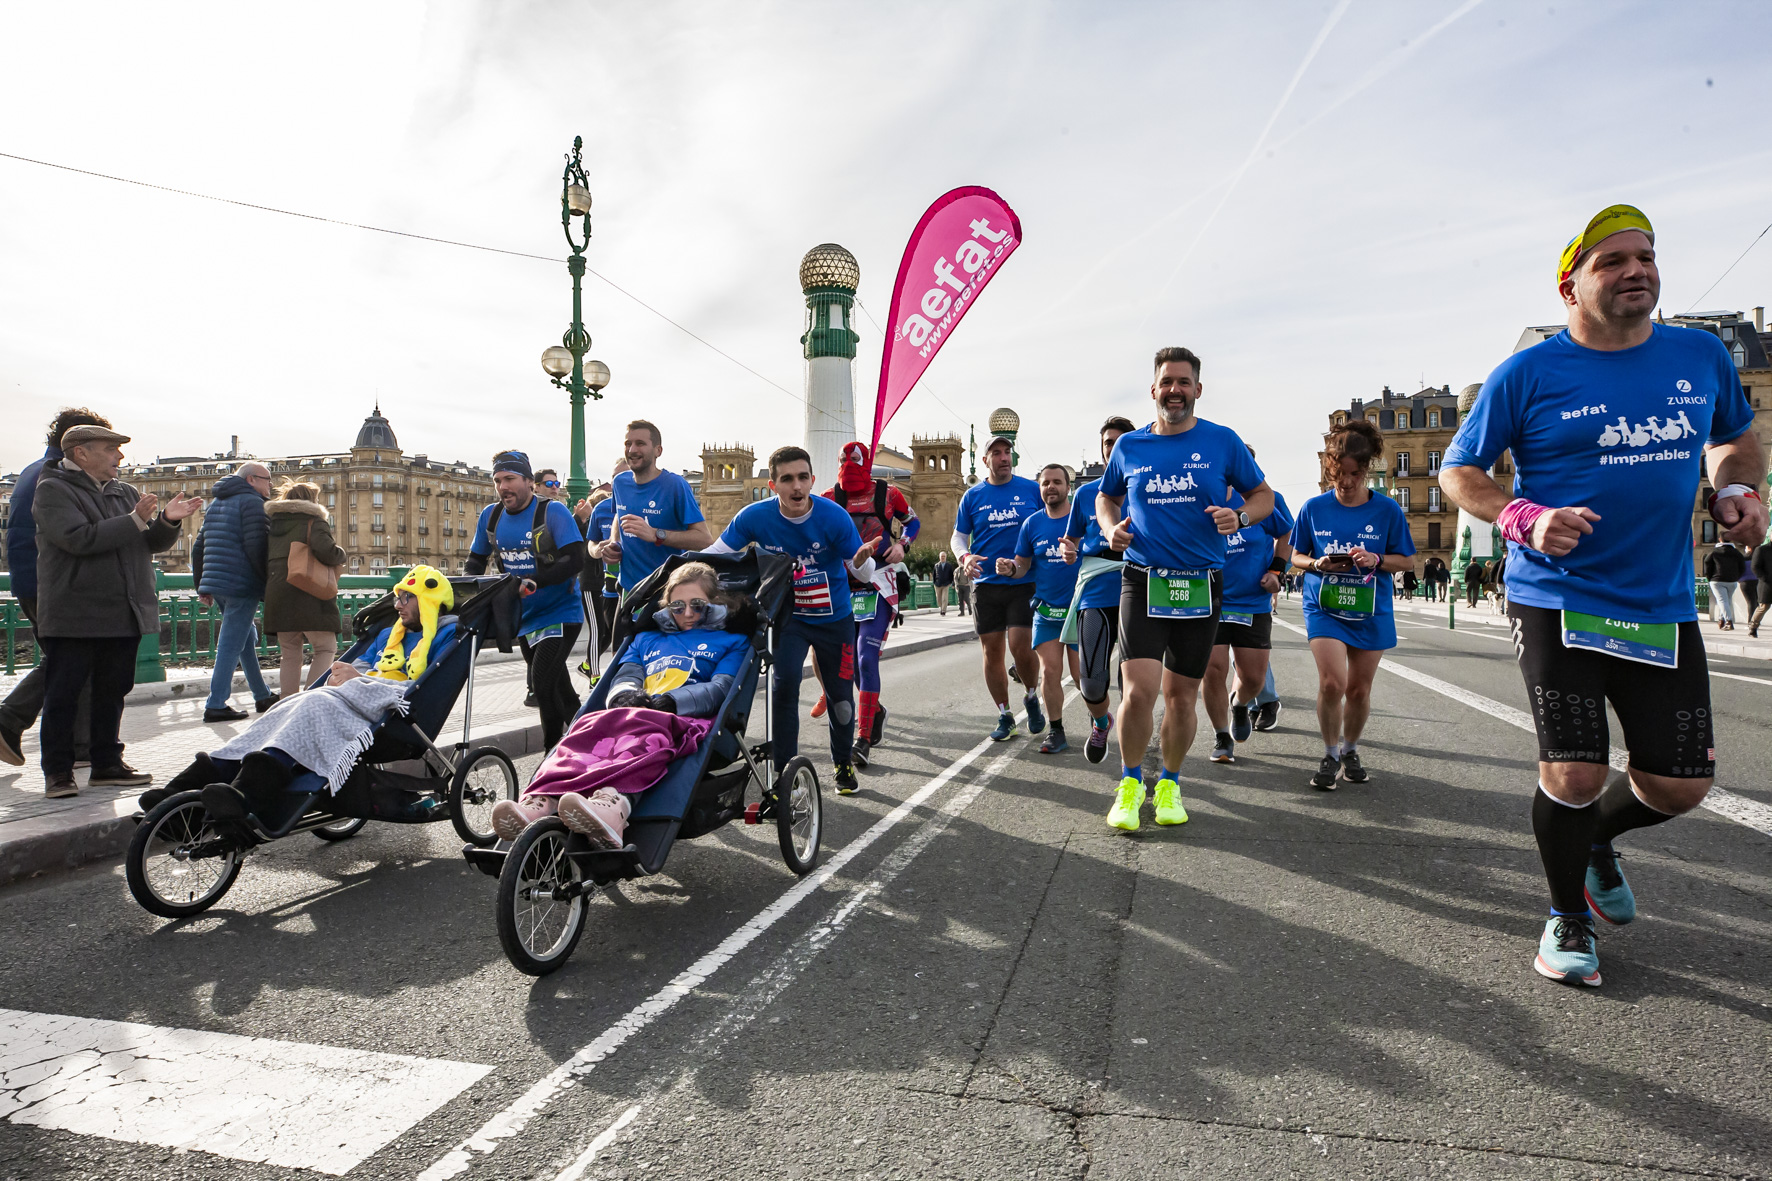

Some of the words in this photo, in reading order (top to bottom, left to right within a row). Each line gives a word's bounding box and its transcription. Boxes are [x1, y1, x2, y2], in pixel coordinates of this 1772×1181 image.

[901, 217, 1007, 347] aefat
[919, 234, 1013, 359] www.aefat.es
[1667, 396, 1707, 405] ZURICH
[1561, 404, 1607, 420] aefat
[1599, 449, 1690, 465] #Imparables
[1133, 465, 1152, 474] aefat
[1147, 496, 1196, 505] #Imparables
[794, 577, 819, 585] ZURICH
[1168, 580, 1189, 588] XABIER
[1170, 590, 1189, 601] 2568
[1338, 596, 1356, 606] 2529
